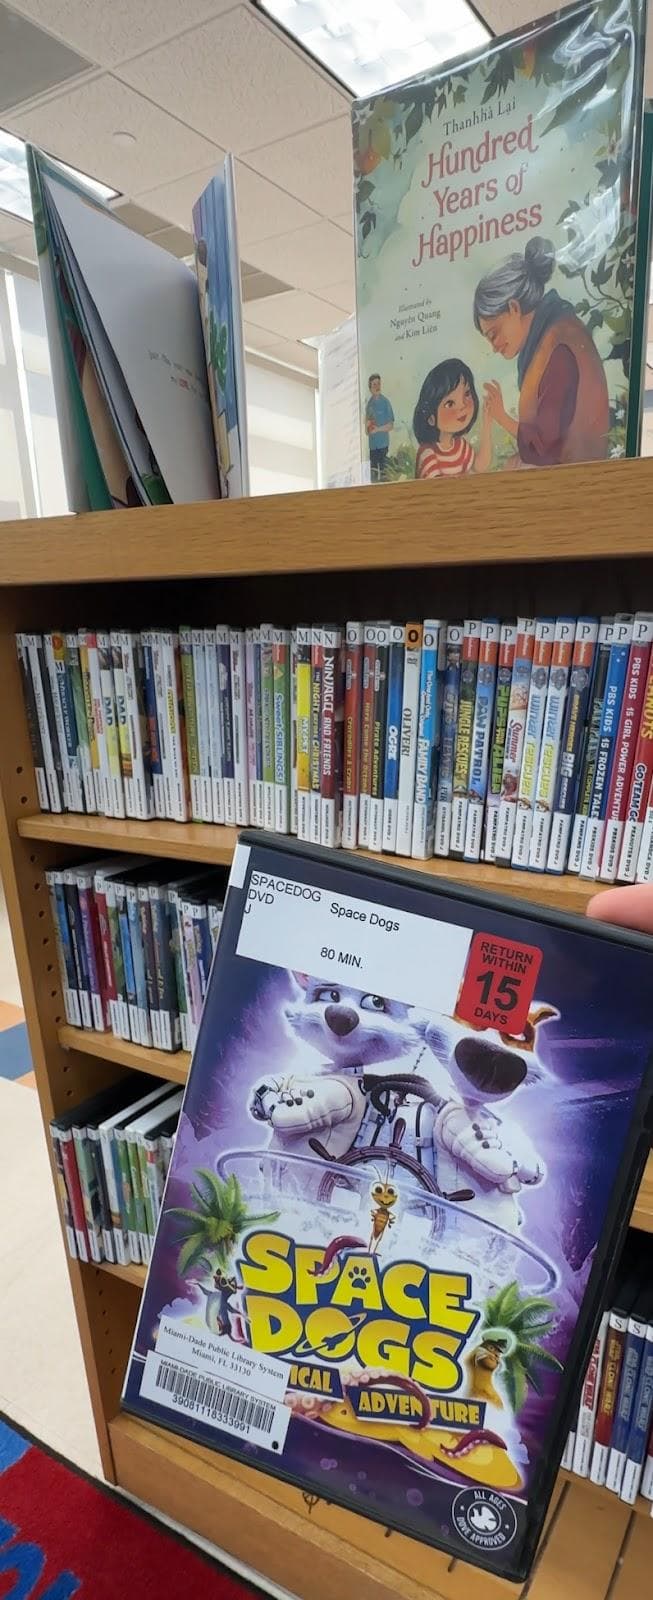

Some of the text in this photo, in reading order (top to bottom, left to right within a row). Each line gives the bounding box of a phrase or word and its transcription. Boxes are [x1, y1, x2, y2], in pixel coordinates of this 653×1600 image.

[421, 113, 539, 189] Hundred
[433, 162, 528, 218] Years of
[412, 203, 543, 267] Happiness
[405, 328, 420, 339] Kim
[325, 632, 333, 645] N
[347, 629, 357, 642] O
[366, 628, 376, 641] O
[376, 630, 386, 643] O
[393, 627, 403, 640] O
[408, 629, 418, 642] O
[450, 629, 460, 642] O
[469, 622, 477, 635] P
[486, 626, 494, 639] P
[504, 628, 512, 641] P
[524, 620, 533, 632] P
[541, 626, 549, 639] P
[561, 626, 569, 639] P
[582, 626, 591, 639] P
[605, 627, 614, 640] P
[618, 627, 628, 640] P
[638, 624, 648, 638] P
[424, 633, 434, 646] O
[632, 657, 642, 677] PBS
[312, 682, 321, 712] NIGHT
[629, 678, 638, 700] KIDS
[104, 697, 113, 726] DAD
[118, 695, 127, 725] DAD
[322, 655, 334, 776] NINJAGO AND FRIENDS
[625, 707, 634, 717] 15
[275, 693, 286, 782] Sweet SIBLINGS!
[402, 708, 413, 757] OLIVER!
[456, 700, 472, 775] JUNGLE RESCUES
[471, 696, 489, 785] PAW PATROL
[510, 719, 523, 763] Summer
[622, 719, 633, 739] GIRL
[388, 725, 398, 761] OGRE
[417, 737, 430, 774] FAMILY
[591, 686, 618, 819] PBS KIDS 15 FROZEN TALE
[311, 739, 321, 789] CHRISTMAS
[371, 721, 381, 796] Pirate Adventures
[491, 744, 504, 794] ALIEN
[561, 752, 575, 778] BIG
[618, 741, 630, 773] POWER
[635, 764, 646, 778] GO
[415, 774, 429, 804] BAND
[631, 778, 643, 810] TEAM
[248, 889, 274, 905] DVD
[250, 874, 322, 903] SPACEDOG
[244, 904, 251, 914] J
[329, 902, 400, 932] Space Dogs
[319, 947, 363, 969] 80 MIN.
[480, 941, 533, 965] RETURN
[482, 953, 527, 974] WITHIN
[476, 970, 521, 1012] 15
[473, 1007, 508, 1025] DAYS
[241, 1233, 478, 1332] SPACE
[615, 1318, 622, 1329] S
[633, 1323, 641, 1334] S
[163, 1326, 284, 1380] Miami-Dade Public Library System
[246, 1295, 463, 1390] DOGS
[192, 1347, 251, 1377] Miami, FL 33130
[199, 1374, 221, 1387] PUBLIC
[222, 1384, 250, 1398] LIBRARY
[250, 1396, 277, 1411] SYSTEM
[172, 1393, 251, 1434] 39081118333991
[357, 1391, 480, 1424] ADVENTURE
[473, 1490, 507, 1510] ALL AGES
[457, 1516, 506, 1546] DOVE APPROVED
